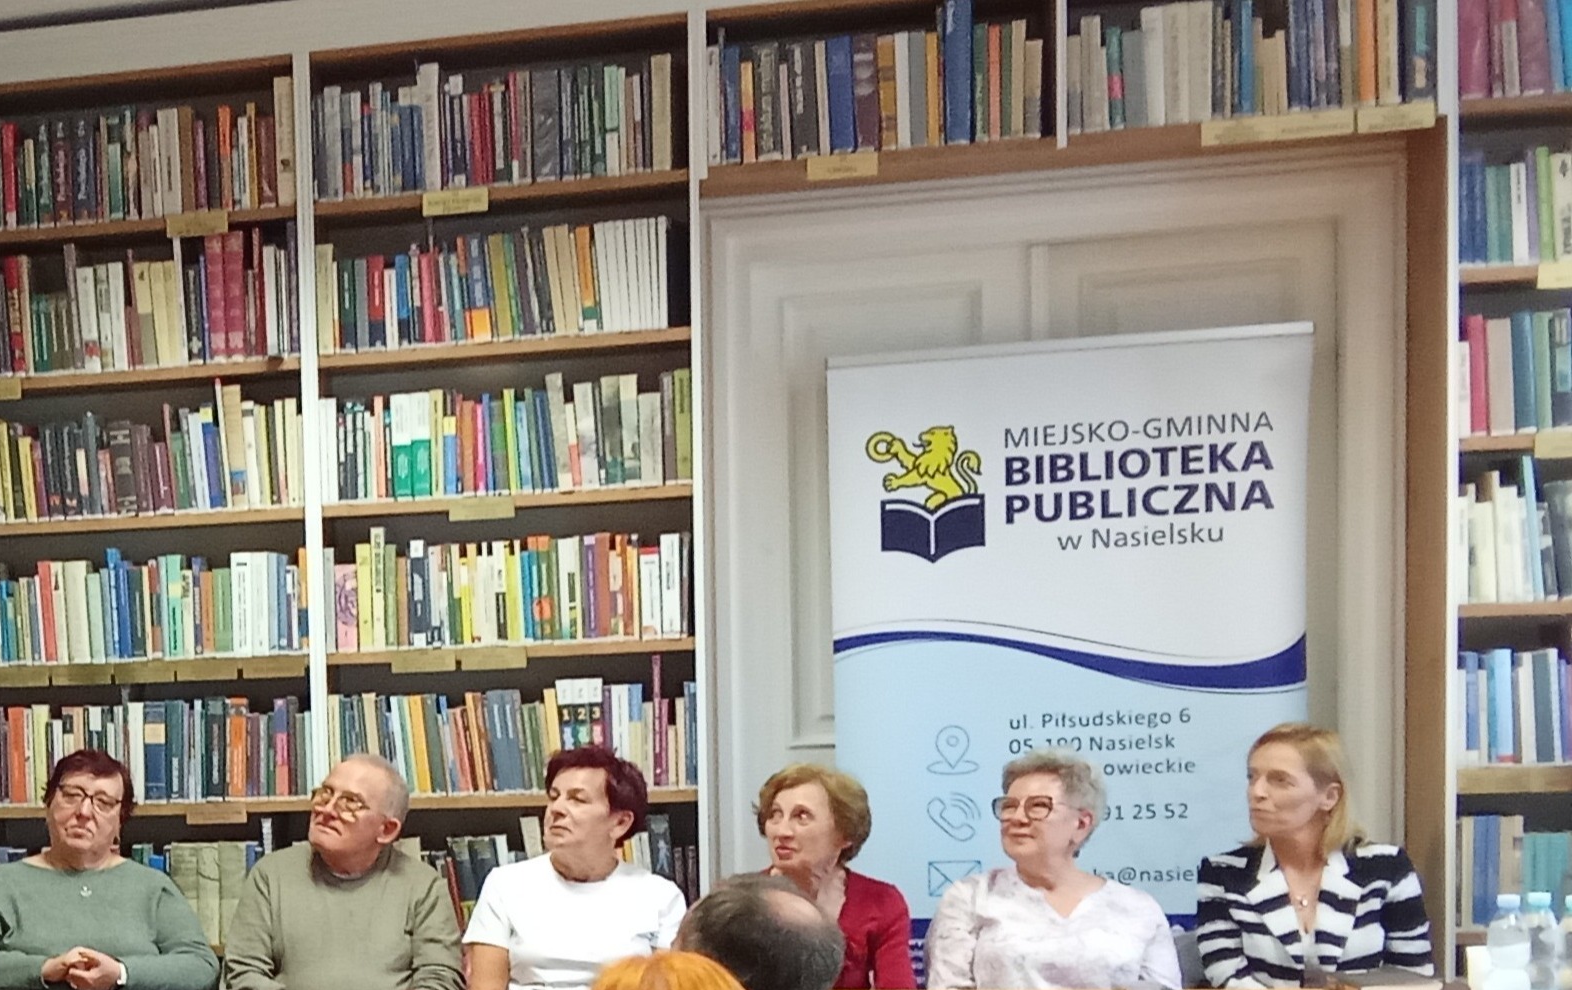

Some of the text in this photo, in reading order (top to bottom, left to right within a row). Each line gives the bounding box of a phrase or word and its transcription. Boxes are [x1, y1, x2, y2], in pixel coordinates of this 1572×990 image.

[1004, 411, 1274, 449] MIEJSKO-GMINNA
[1005, 440, 1274, 486] BIBLIOTEKA
[1005, 480, 1275, 524] PUBLICZNA
[1057, 522, 1224, 550] w Nasielsku
[1041, 709, 1172, 729] Piłsudskiego
[1179, 707, 1191, 724] 6
[1089, 734, 1176, 751] Nasielsk
[1103, 758, 1196, 776] owieckie
[1132, 803, 1156, 820] 25
[1164, 803, 1188, 819] 52
